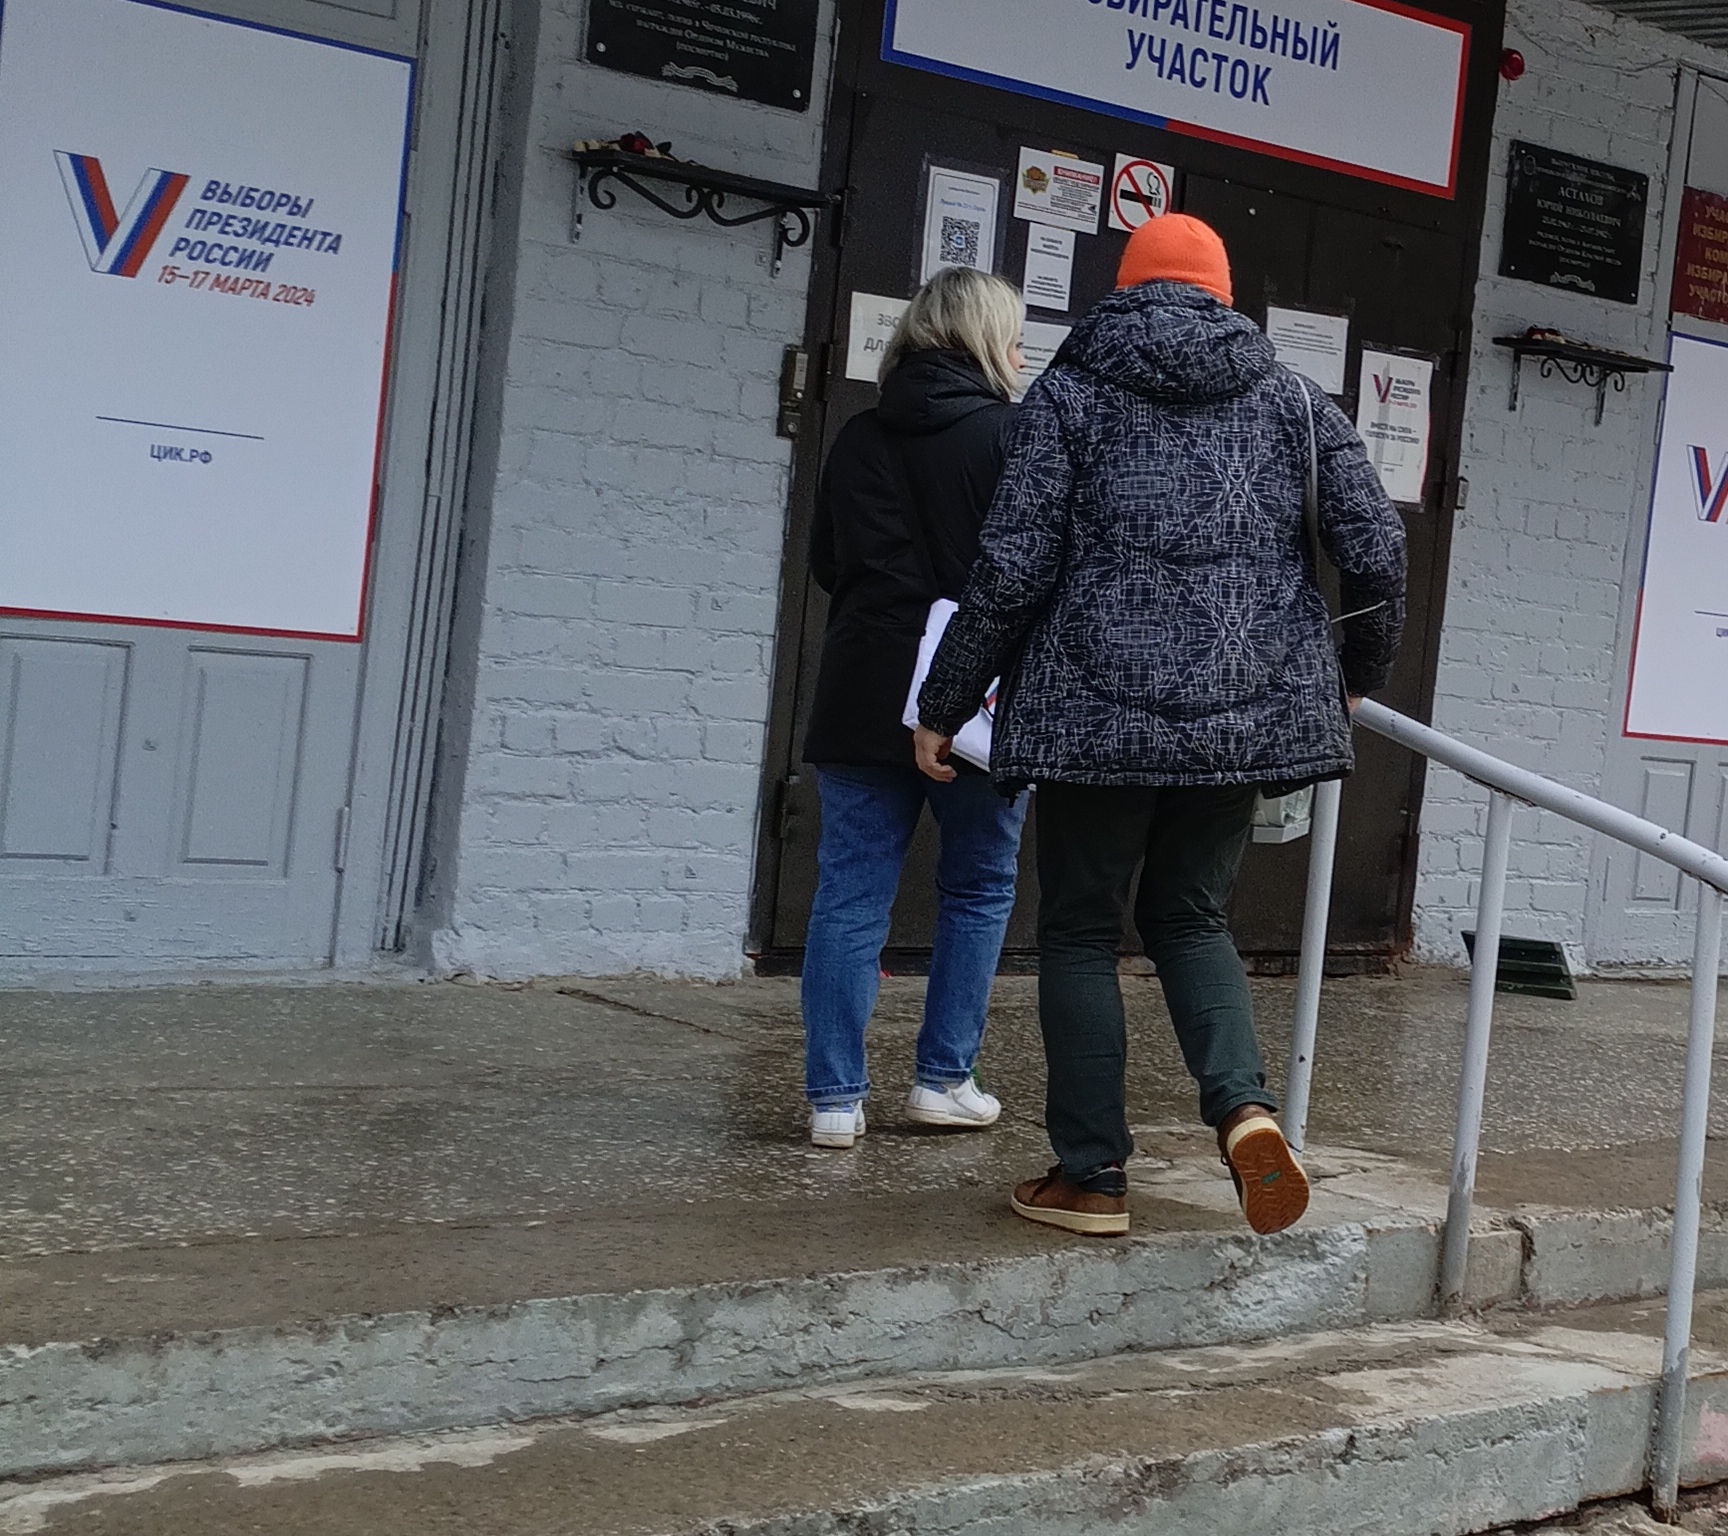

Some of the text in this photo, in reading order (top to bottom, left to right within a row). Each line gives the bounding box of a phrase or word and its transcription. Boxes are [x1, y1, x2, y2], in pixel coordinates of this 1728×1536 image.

[1125, 28, 1273, 106] УЧАСТОК
[200, 179, 315, 219] ВЫБОРЫ
[185, 207, 343, 255] ПРЕЗИДЕНТА
[169, 236, 275, 273] РОССИИ
[208, 273, 272, 300] МАРТА
[272, 282, 316, 307] 2024
[149, 444, 213, 464] ЦИК.РФ
